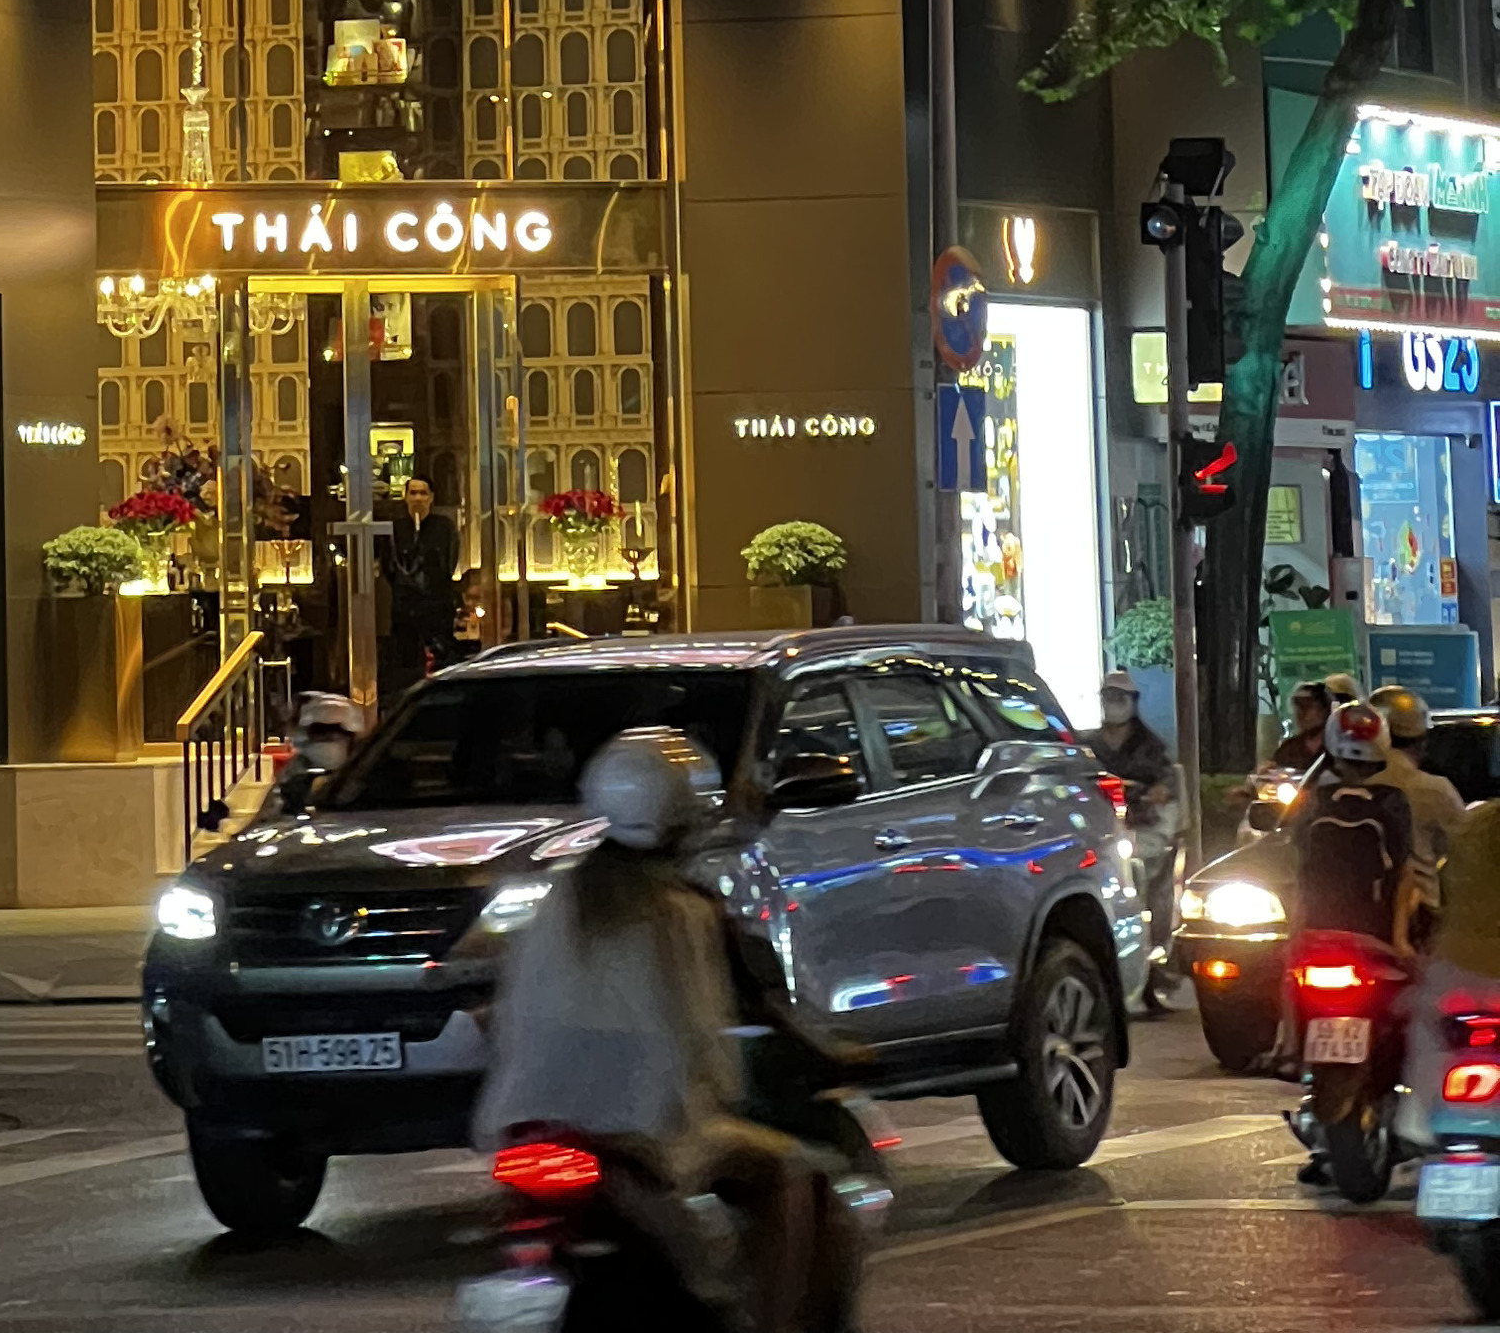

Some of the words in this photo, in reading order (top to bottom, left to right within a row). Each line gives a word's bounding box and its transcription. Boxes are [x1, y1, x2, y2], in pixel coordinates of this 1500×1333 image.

[211, 203, 358, 253] THÁI
[385, 202, 552, 253] CÔNG
[734, 414, 796, 438] THÁI
